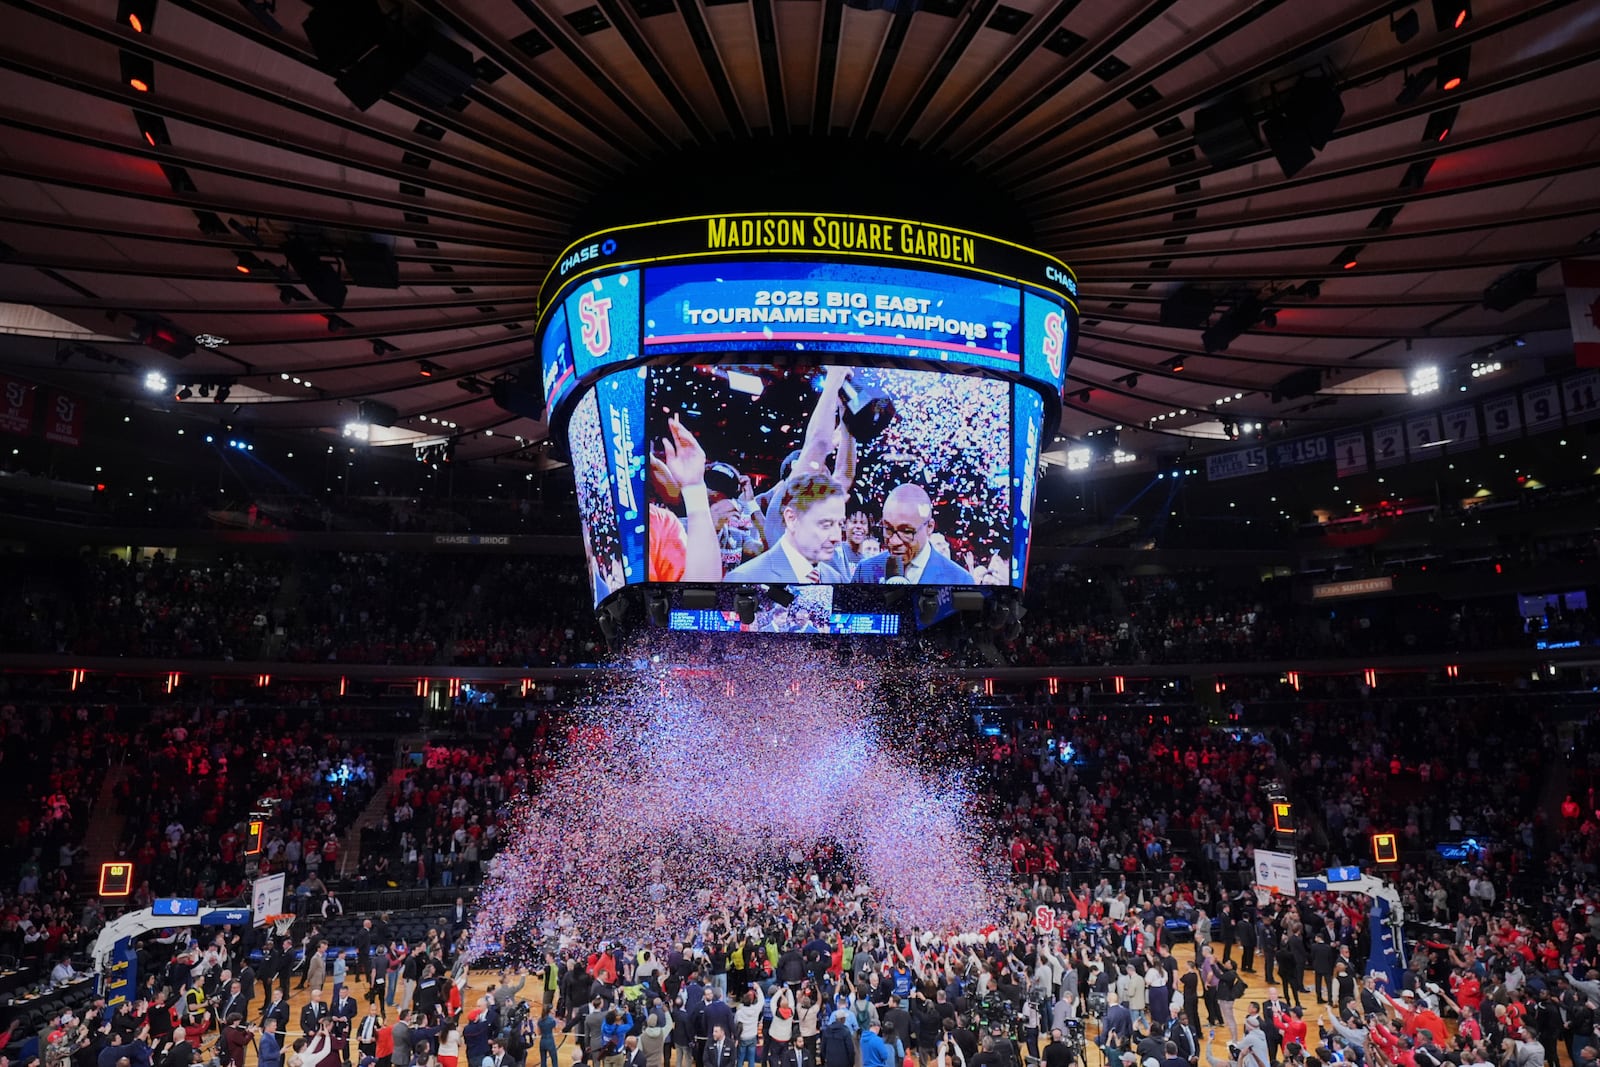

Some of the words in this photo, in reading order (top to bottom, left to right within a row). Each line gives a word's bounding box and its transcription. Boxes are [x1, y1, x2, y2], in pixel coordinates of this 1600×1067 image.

[708, 216, 805, 249] MADISON
[812, 216, 894, 252] SQUARE
[899, 222, 975, 265] GARDEN
[560, 243, 600, 276] CHASE
[755, 291, 819, 306] 2025
[826, 291, 868, 308] BIG
[875, 294, 931, 314] EAST
[687, 307, 852, 324] TOURNAMENT
[853, 310, 988, 340] CHAMPIONS
[1572, 386, 1596, 411] 11
[1495, 409, 1509, 430] 9
[1535, 399, 1549, 421] 9
[1453, 420, 1467, 440] 7
[1246, 448, 1265, 466] 15
[1296, 437, 1327, 461] 150
[1345, 446, 1356, 465] 1
[1382, 437, 1396, 457] 2
[1210, 461, 1243, 474] STYLES
[435, 535, 469, 545] CHASE
[480, 536, 509, 545] BRIDGE
[226, 913, 242, 921] Jeep
